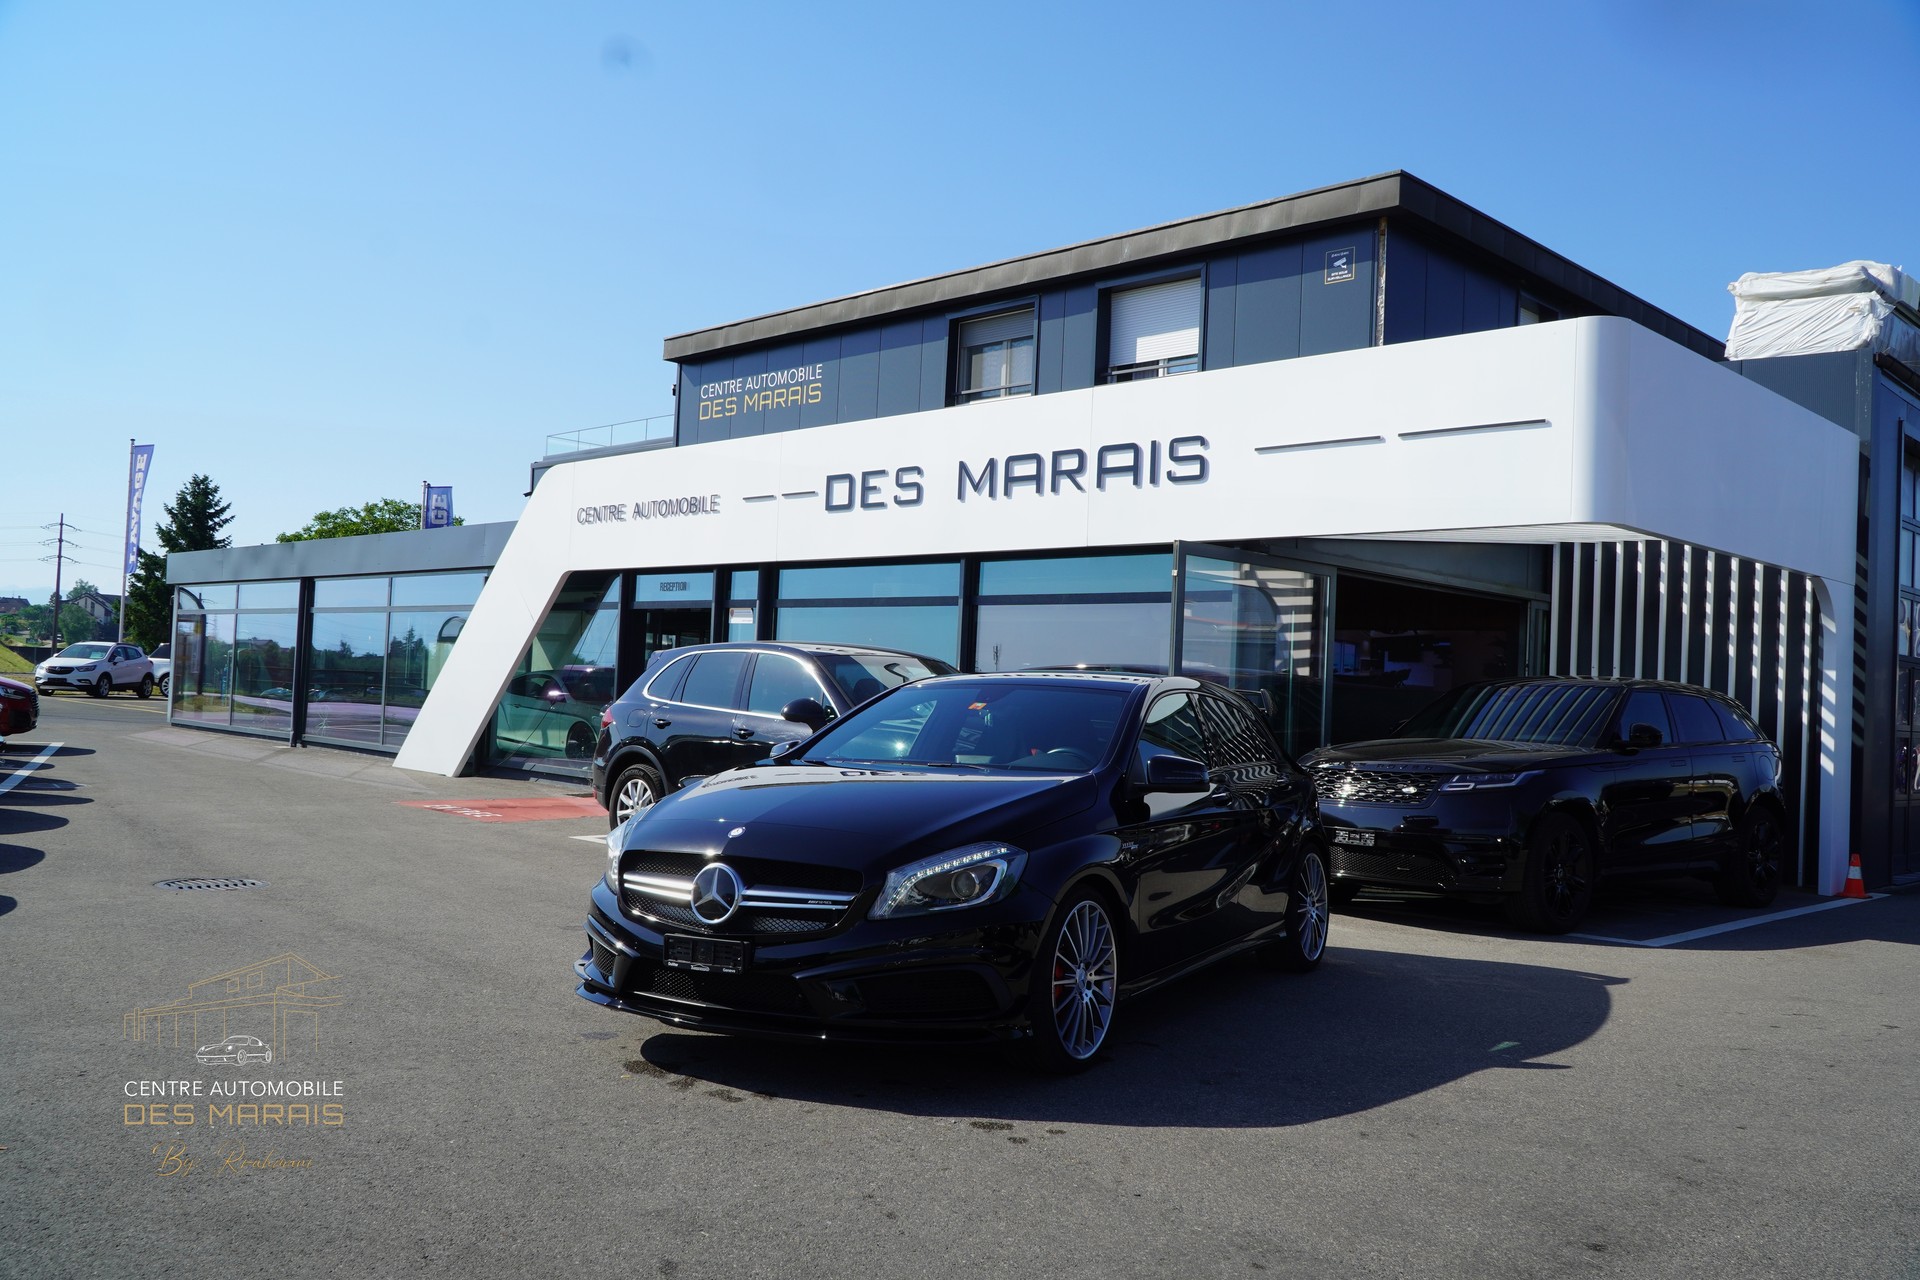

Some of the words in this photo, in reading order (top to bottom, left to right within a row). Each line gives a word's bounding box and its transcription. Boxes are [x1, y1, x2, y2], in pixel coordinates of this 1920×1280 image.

[701, 379, 742, 399] CENTRE
[745, 364, 823, 391] AUTOMOBILE
[699, 397, 737, 420] DES
[743, 383, 822, 413] MARAIS
[577, 503, 626, 525] CENTRE
[632, 494, 720, 520] AUTOMOBILE
[825, 466, 923, 513] DES
[957, 435, 1208, 501] MARAIS
[129, 454, 148, 563] LAVAGE
[431, 494, 448, 527] GE
[660, 581, 688, 592] RECEPTION
